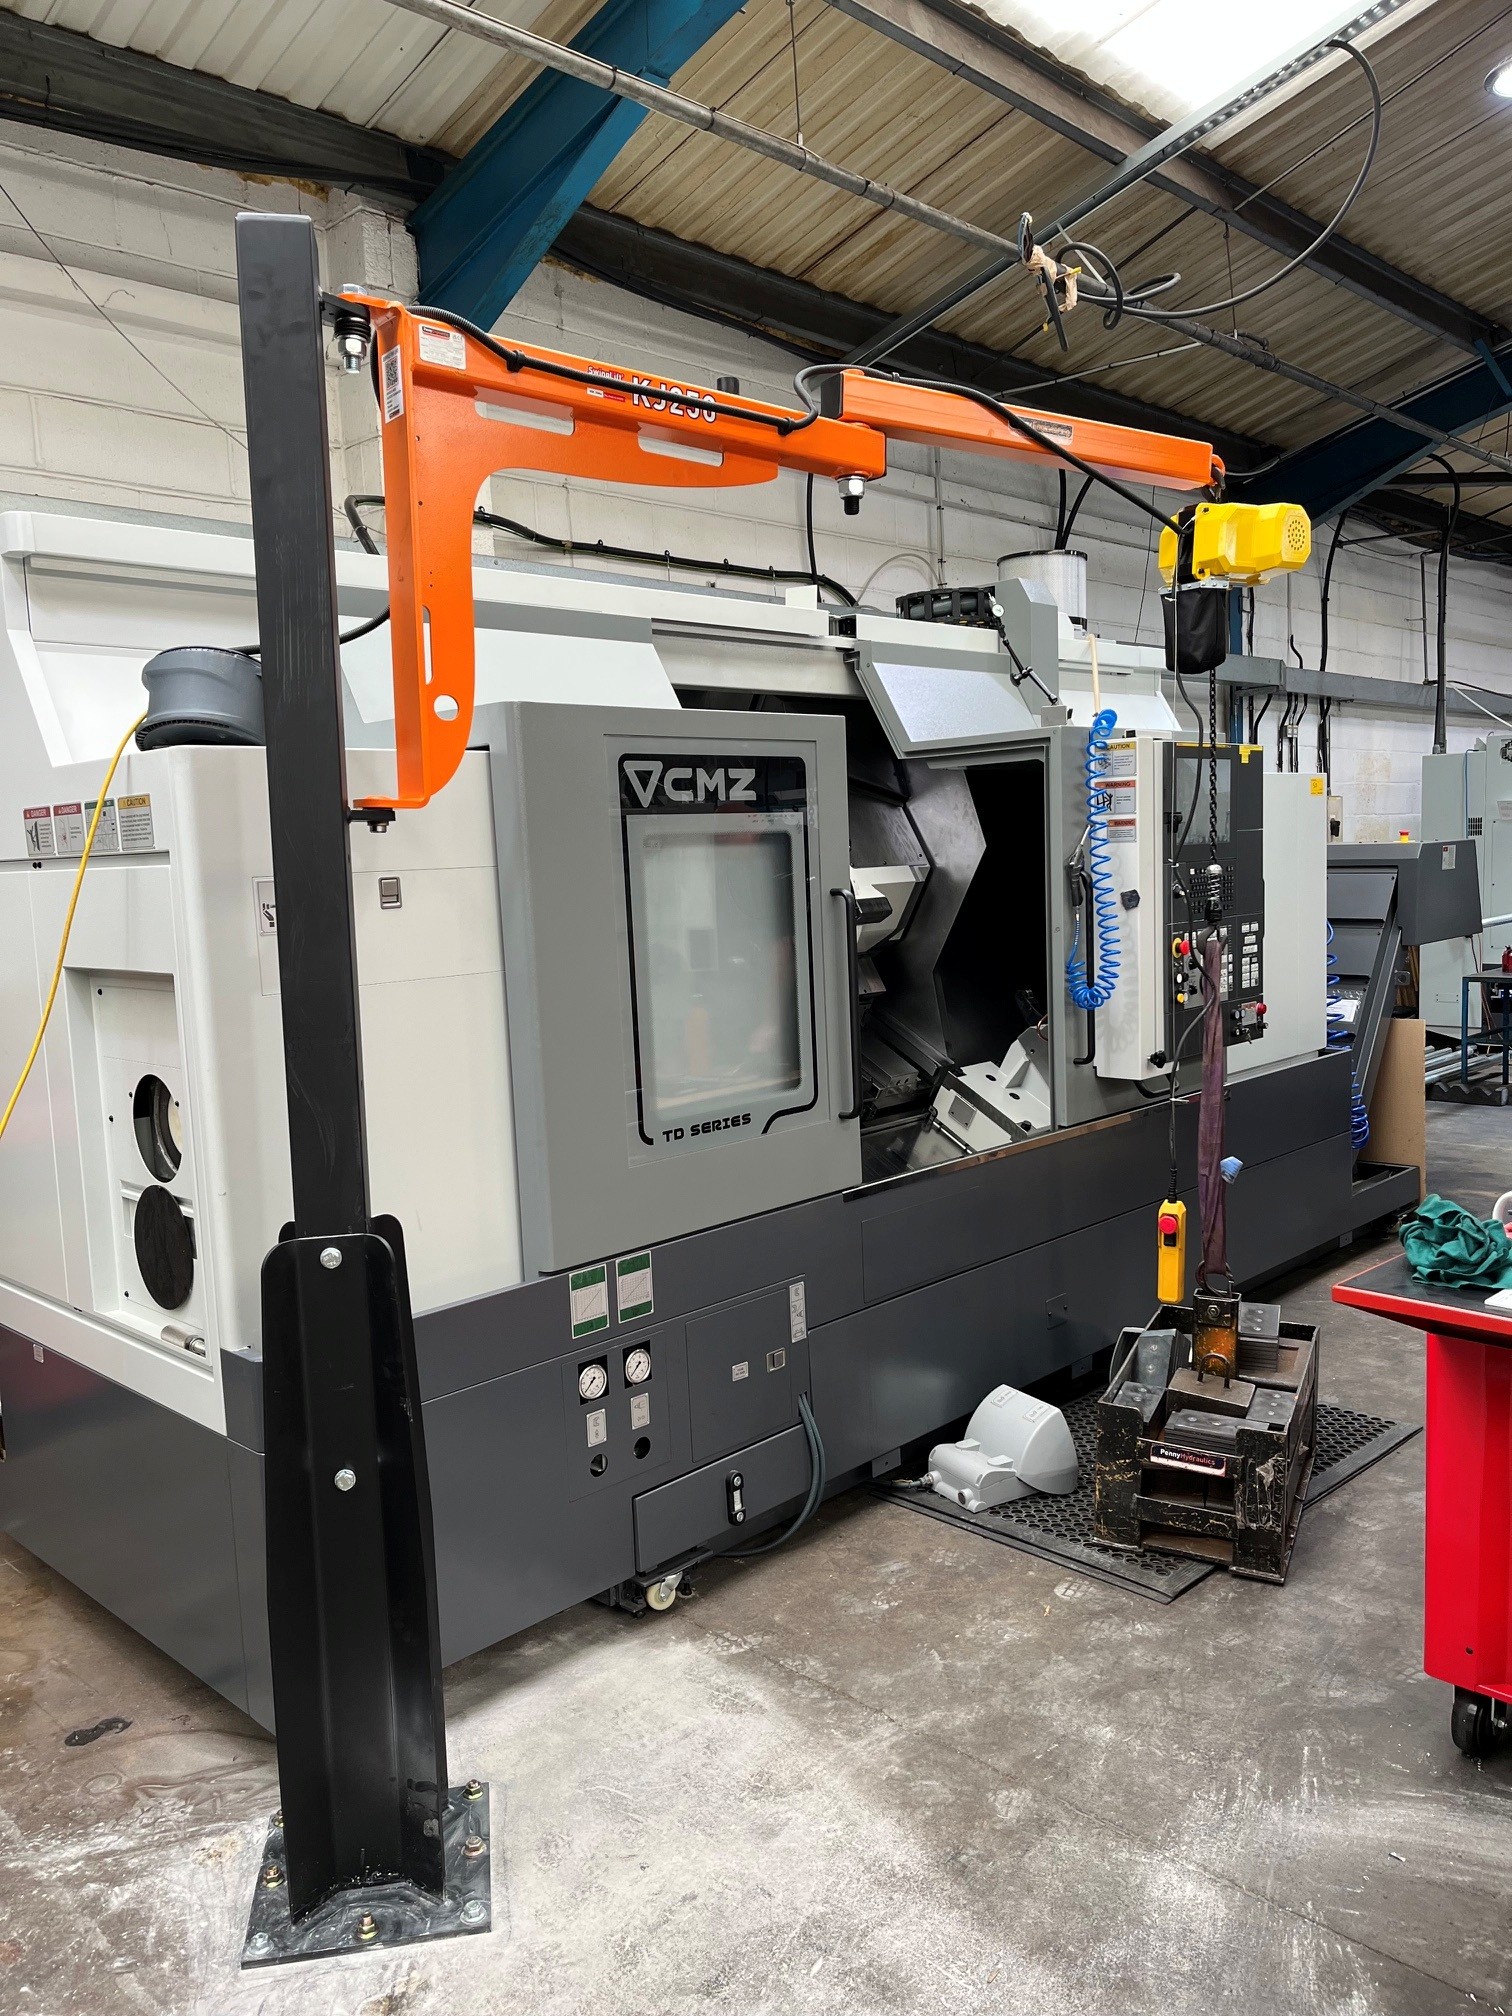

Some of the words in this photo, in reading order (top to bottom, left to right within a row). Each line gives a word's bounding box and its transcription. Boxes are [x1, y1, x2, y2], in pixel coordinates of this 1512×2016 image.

[632, 376, 717, 423] KJ250
[1107, 743, 1130, 751] CAUTION
[663, 767, 757, 801] CMZ
[126, 797, 146, 807] CAUTION
[31, 809, 47, 818] DANGER
[60, 805, 78, 814] DANGER
[662, 1127, 685, 1142] TD
[690, 1112, 752, 1137] SERIES
[1160, 1448, 1216, 1466] PennyHydraulics
